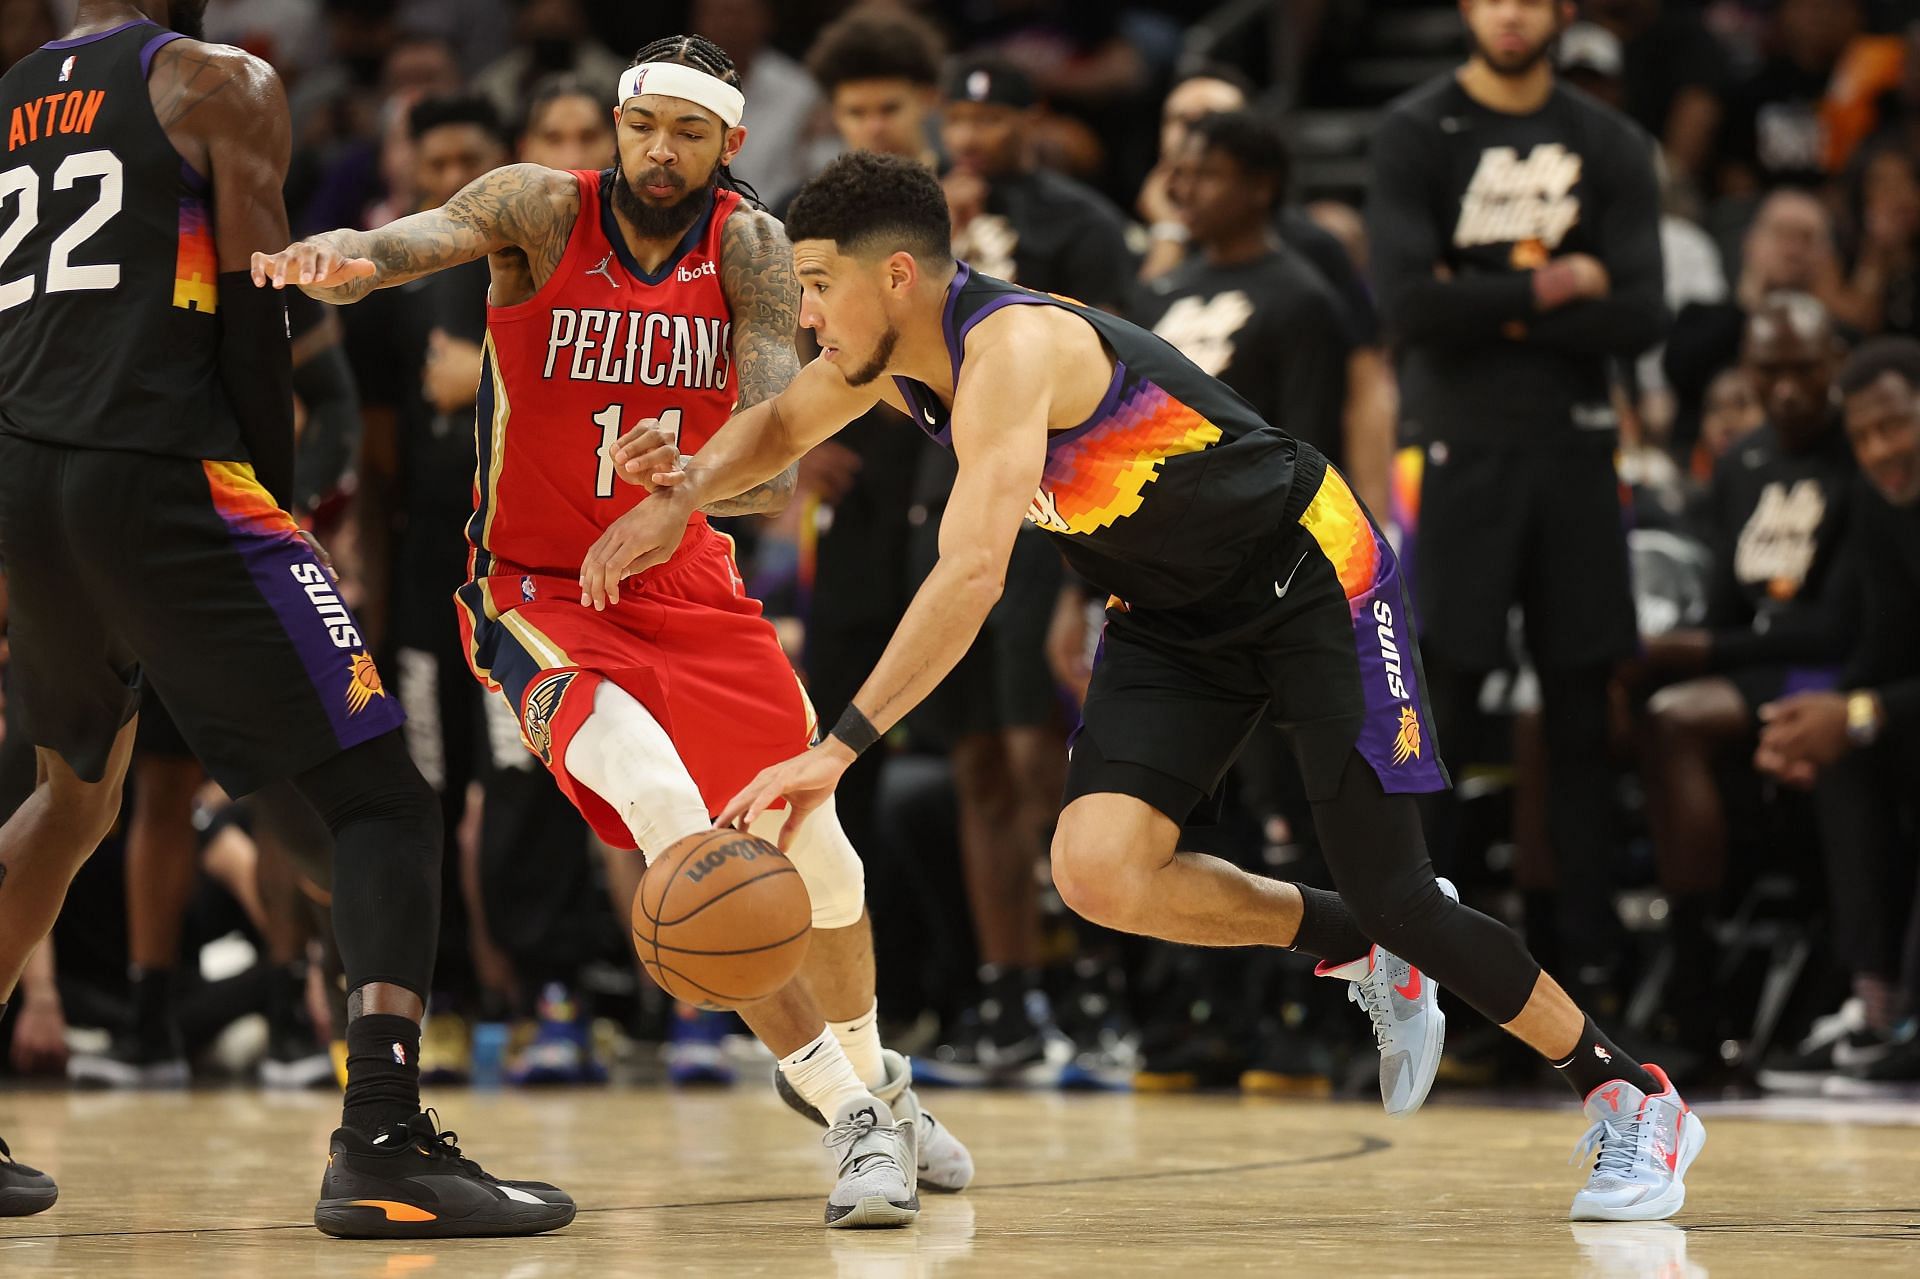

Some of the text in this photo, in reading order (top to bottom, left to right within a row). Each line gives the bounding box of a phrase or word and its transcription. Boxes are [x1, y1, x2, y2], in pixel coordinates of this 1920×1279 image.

[8, 89, 106, 152] AYTON
[0, 149, 124, 312] 22
[543, 308, 731, 390] PELICANS
